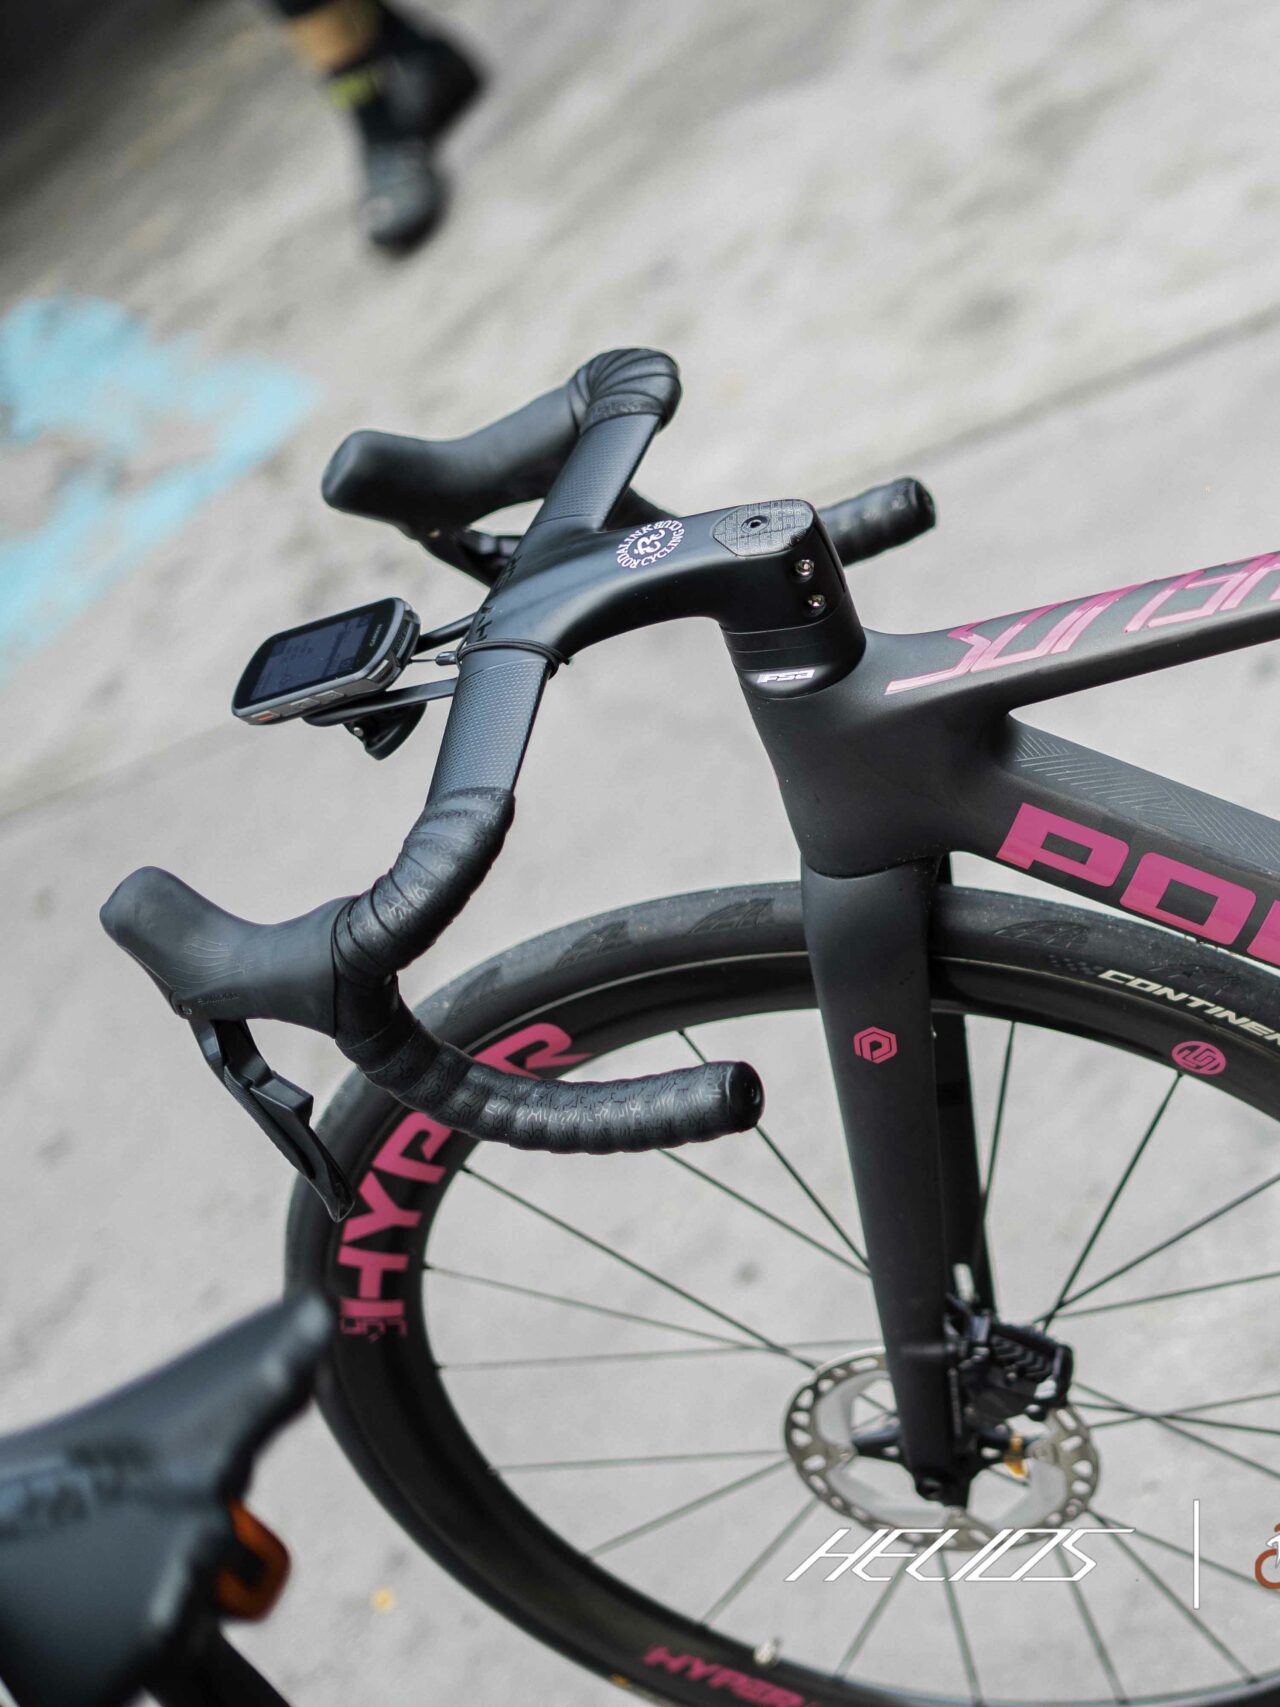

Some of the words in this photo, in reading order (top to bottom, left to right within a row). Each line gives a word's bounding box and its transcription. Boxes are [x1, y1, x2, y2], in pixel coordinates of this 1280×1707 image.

[616, 524, 654, 569] RODALINK
[640, 528, 685, 567] CYCLING
[756, 668, 816, 684] FSA
[337, 1022, 594, 1318] HYPR
